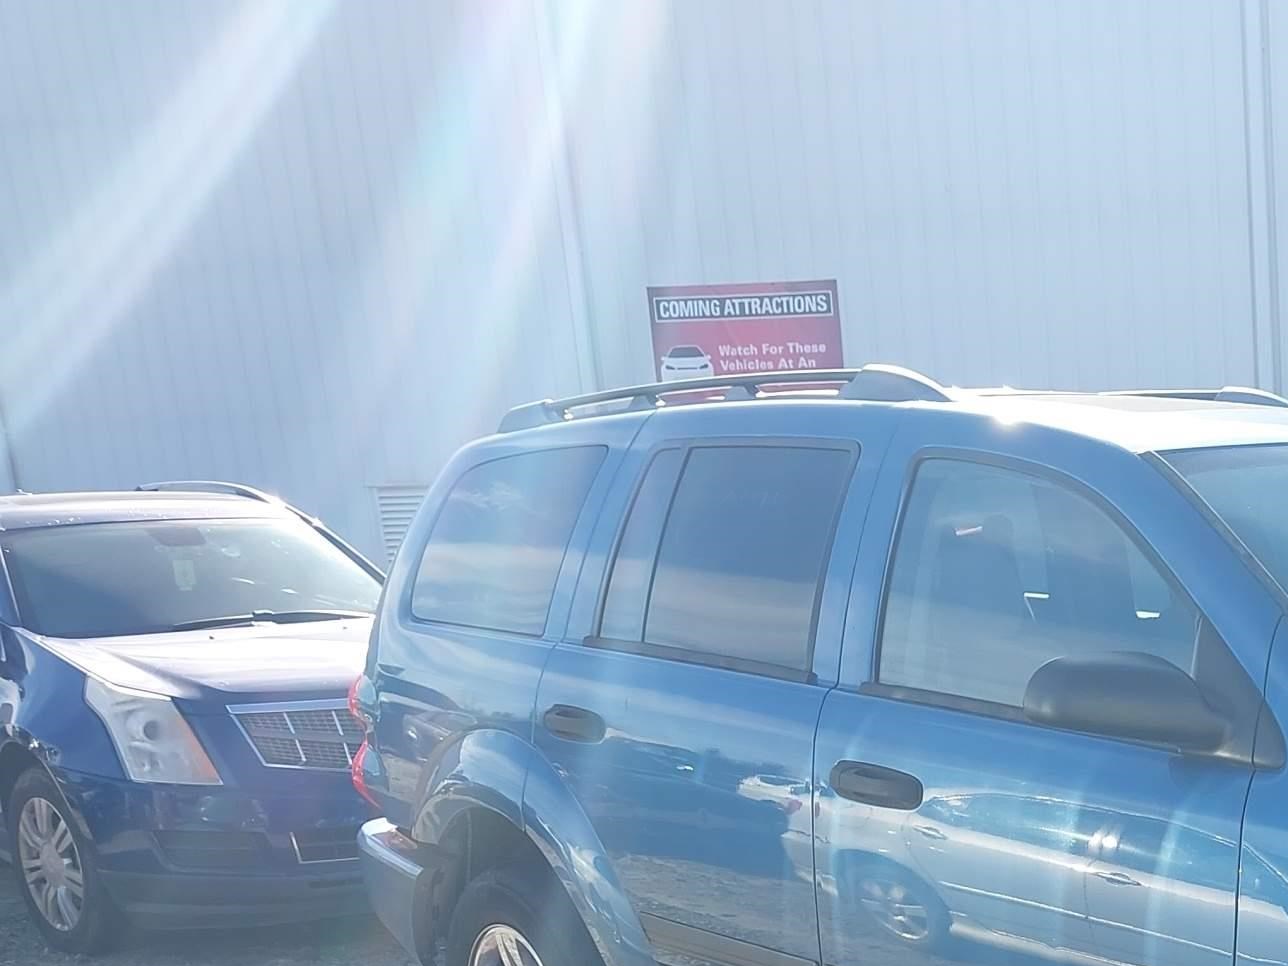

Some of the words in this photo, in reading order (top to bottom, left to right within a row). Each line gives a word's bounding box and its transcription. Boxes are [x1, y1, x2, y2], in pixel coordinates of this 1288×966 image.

[659, 298, 721, 318] COMING
[723, 294, 828, 317] ATTRACTIONS
[718, 344, 759, 357] Watch
[762, 343, 784, 356] For
[786, 341, 827, 354] These
[720, 359, 774, 372] Vehicles
[778, 358, 794, 369] At
[797, 357, 817, 369] An
